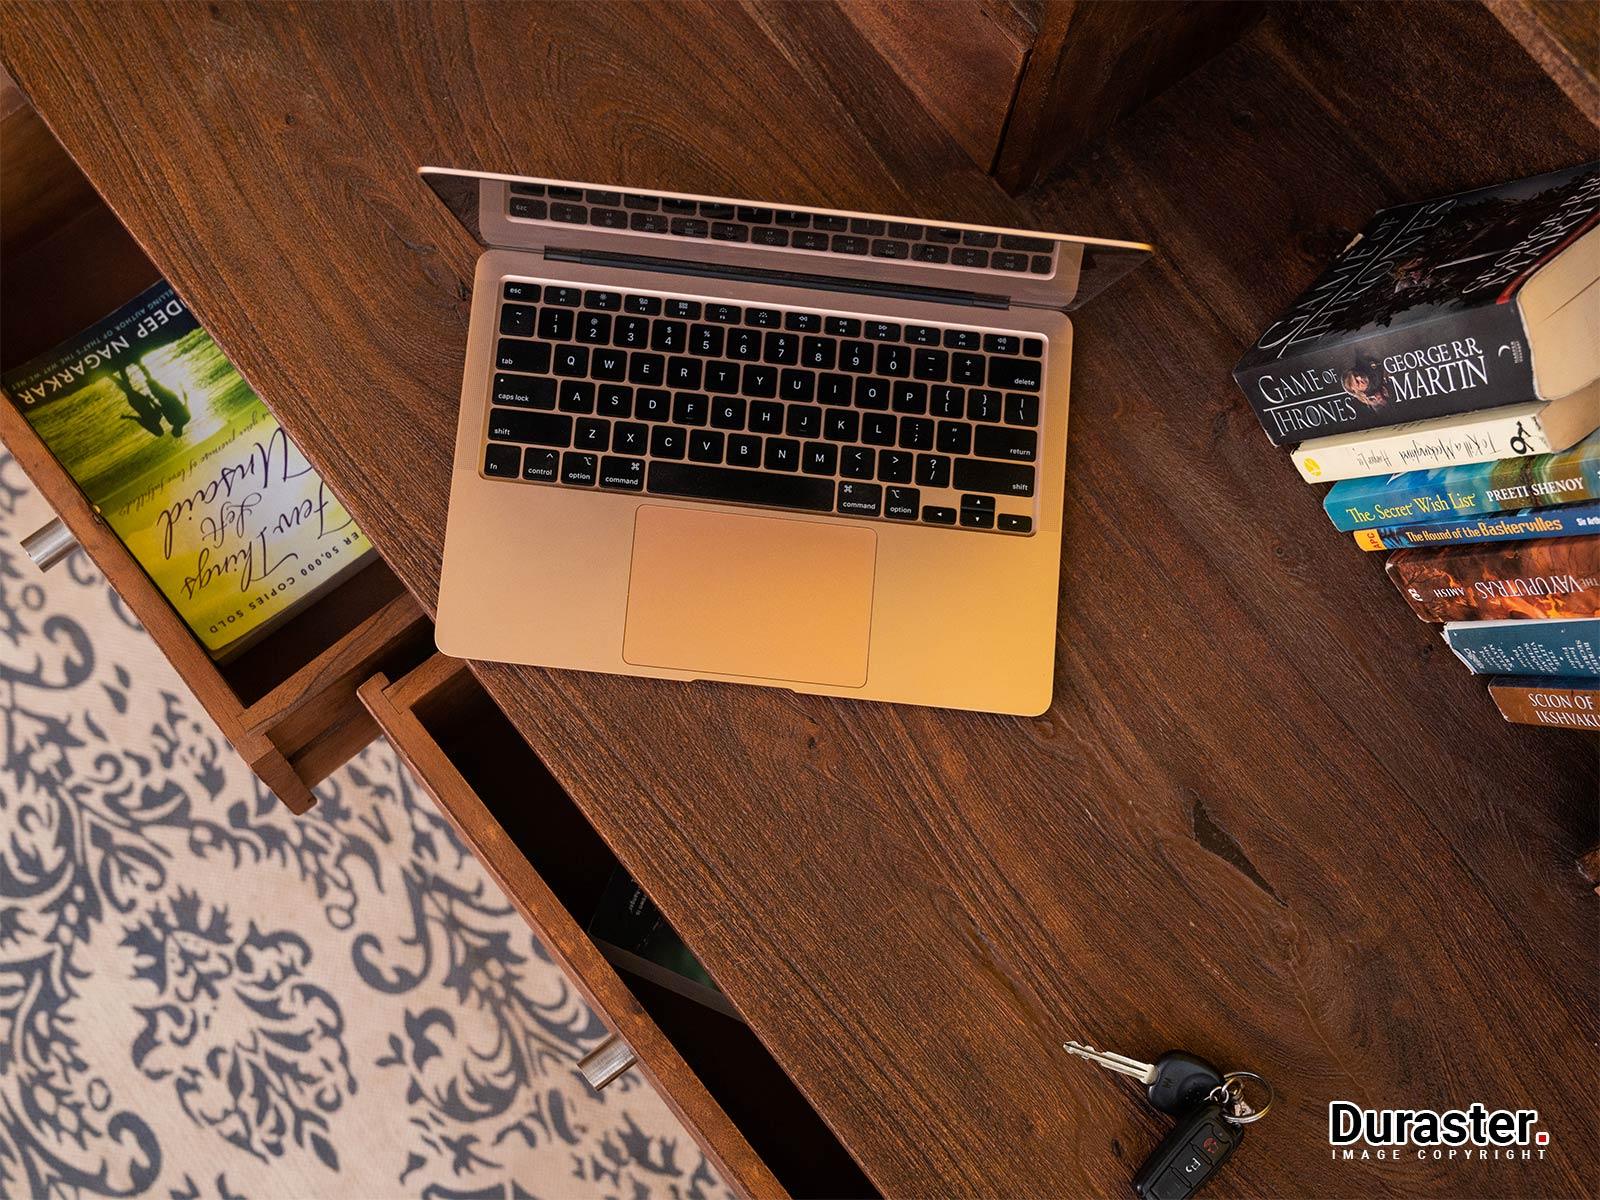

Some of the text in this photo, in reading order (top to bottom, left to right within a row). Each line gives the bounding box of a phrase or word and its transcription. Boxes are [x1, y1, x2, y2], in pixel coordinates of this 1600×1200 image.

[1462, 209, 1571, 294] GEORGE
[509, 287, 522, 295] esc
[501, 357, 514, 365] tab
[1383, 343, 1452, 374] GEORGE
[18, 335, 130, 405] NAGARKAR
[1014, 377, 1035, 386] delete
[1257, 368, 1339, 405] GAME OF
[1388, 355, 1490, 403] MARTIN
[497, 393, 529, 402] caps lock
[1263, 397, 1358, 438] THRONES
[494, 427, 511, 436] shift
[1009, 448, 1031, 456] return
[489, 462, 498, 470] fn
[527, 468, 553, 476] control
[568, 472, 591, 480] option
[604, 476, 639, 486] command
[156, 426, 313, 561] Unsaid
[1012, 483, 1029, 491] shift
[842, 501, 876, 510] command
[1345, 477, 1585, 524] The Secret Wish List PREETI SHENOY
[889, 506, 912, 514] option
[200, 492, 262, 549] Left
[1405, 531, 1425, 543] The
[1423, 528, 1451, 542] Hound
[1451, 527, 1464, 539] of
[1464, 525, 1481, 538] the
[1477, 516, 1564, 537] Baskervilles
[180, 481, 355, 601] Few Things
[1367, 532, 1381, 549] APC
[208, 531, 360, 634] ER 50,000 COPIES SOLD
[1474, 574, 1584, 600] VAYUPUTRAS
[1432, 587, 1466, 598] AMISH
[1528, 693, 1594, 710] SCION OF
